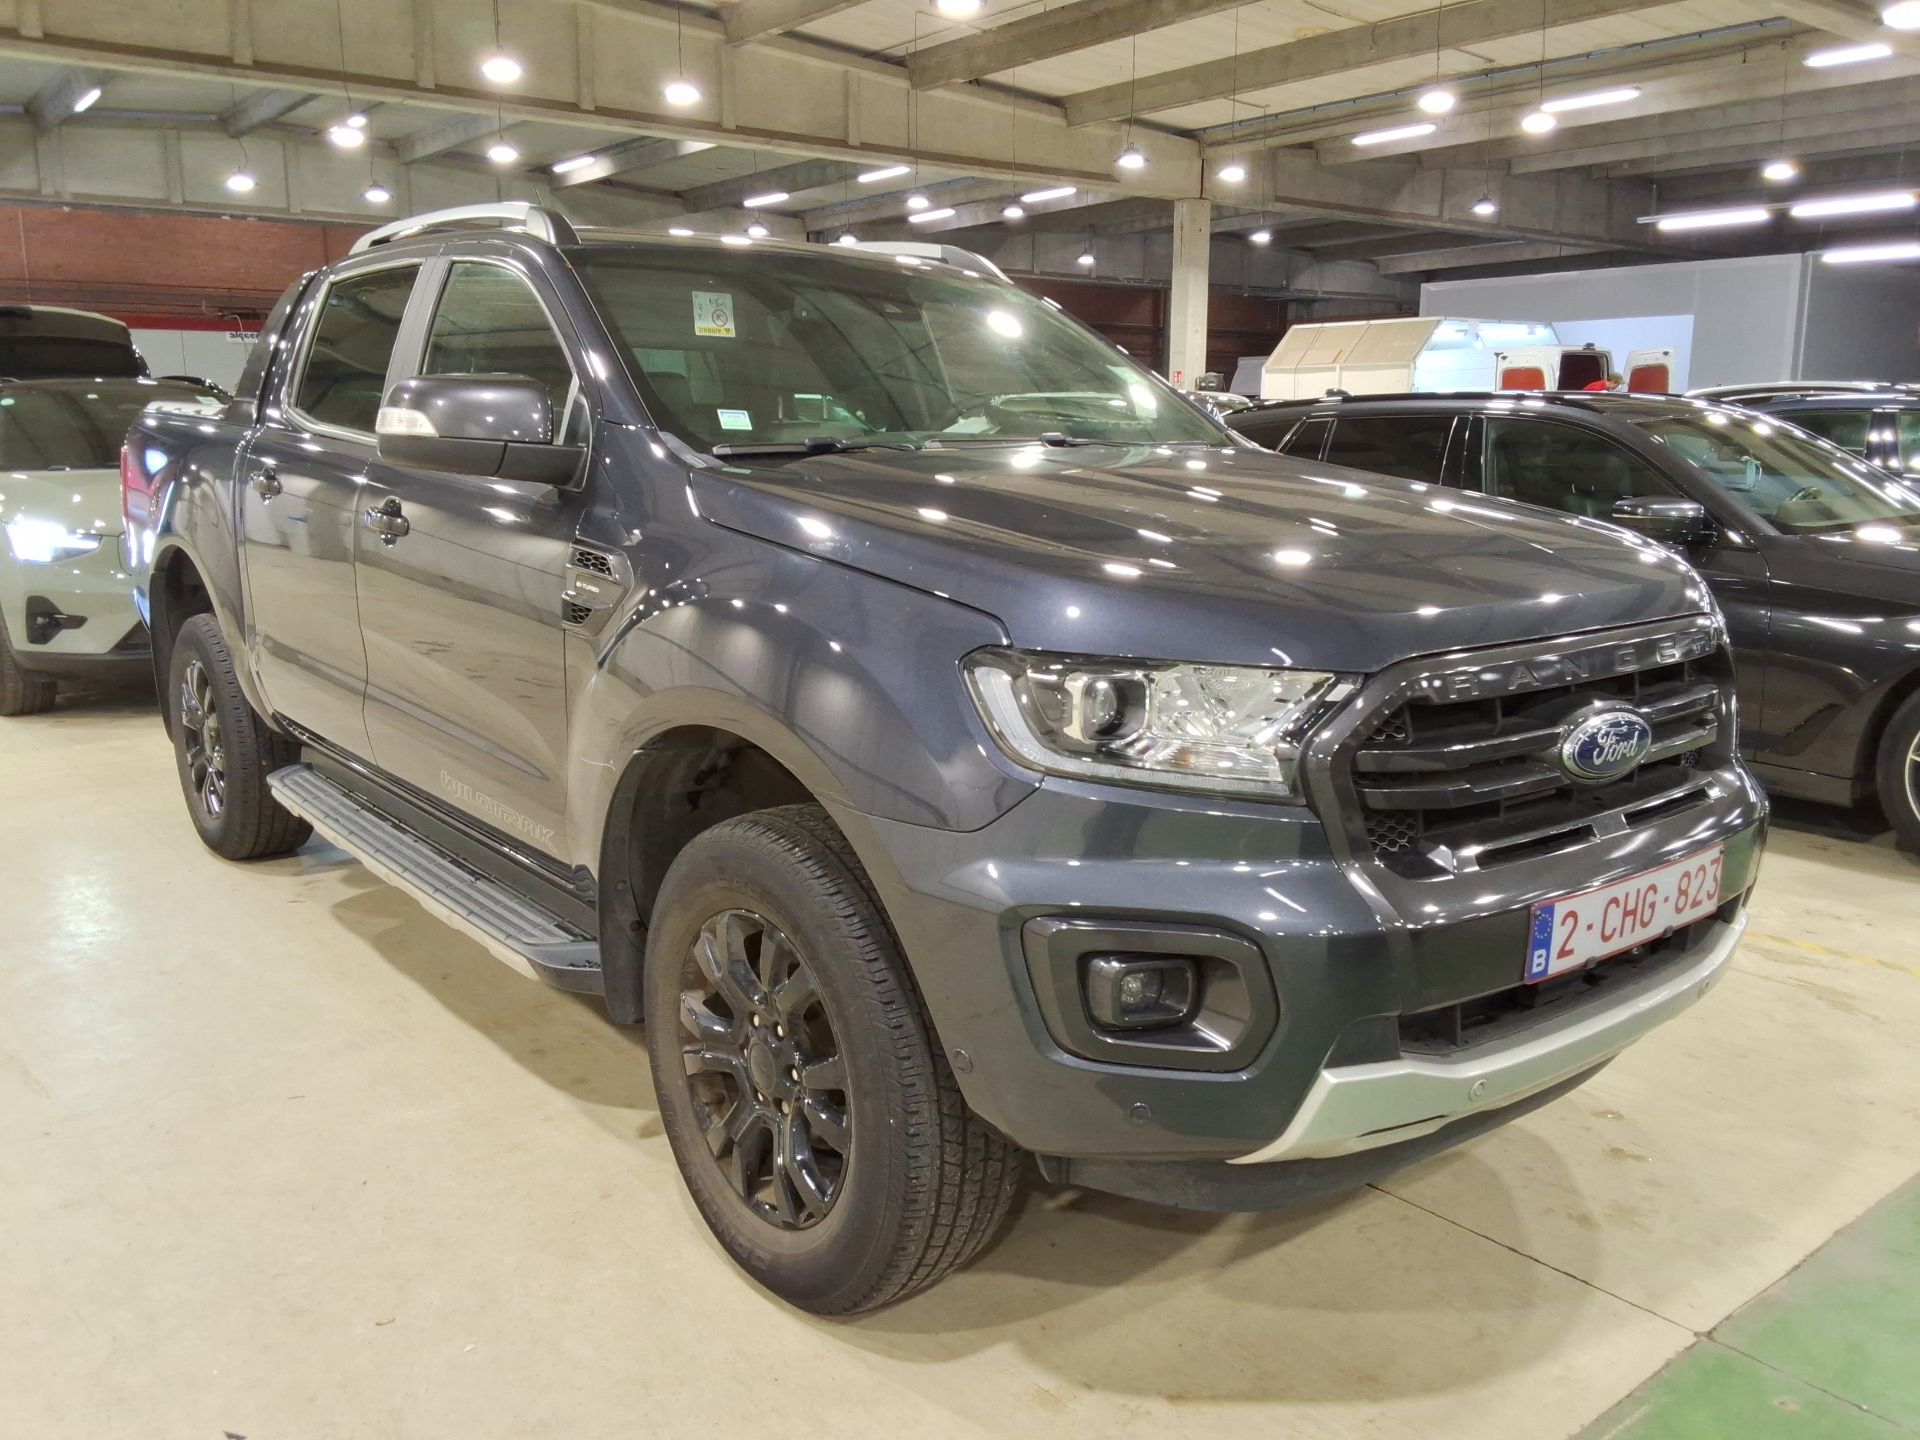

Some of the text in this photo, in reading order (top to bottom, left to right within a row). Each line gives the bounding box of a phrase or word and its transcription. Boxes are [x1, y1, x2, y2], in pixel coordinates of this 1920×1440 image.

[1449, 634, 1711, 698] RANGER
[1593, 725, 1639, 766] Ford
[441, 769, 558, 853] WILDTRAK
[1556, 855, 1722, 960] 2-CHG-823
[1532, 949, 1547, 974] B
